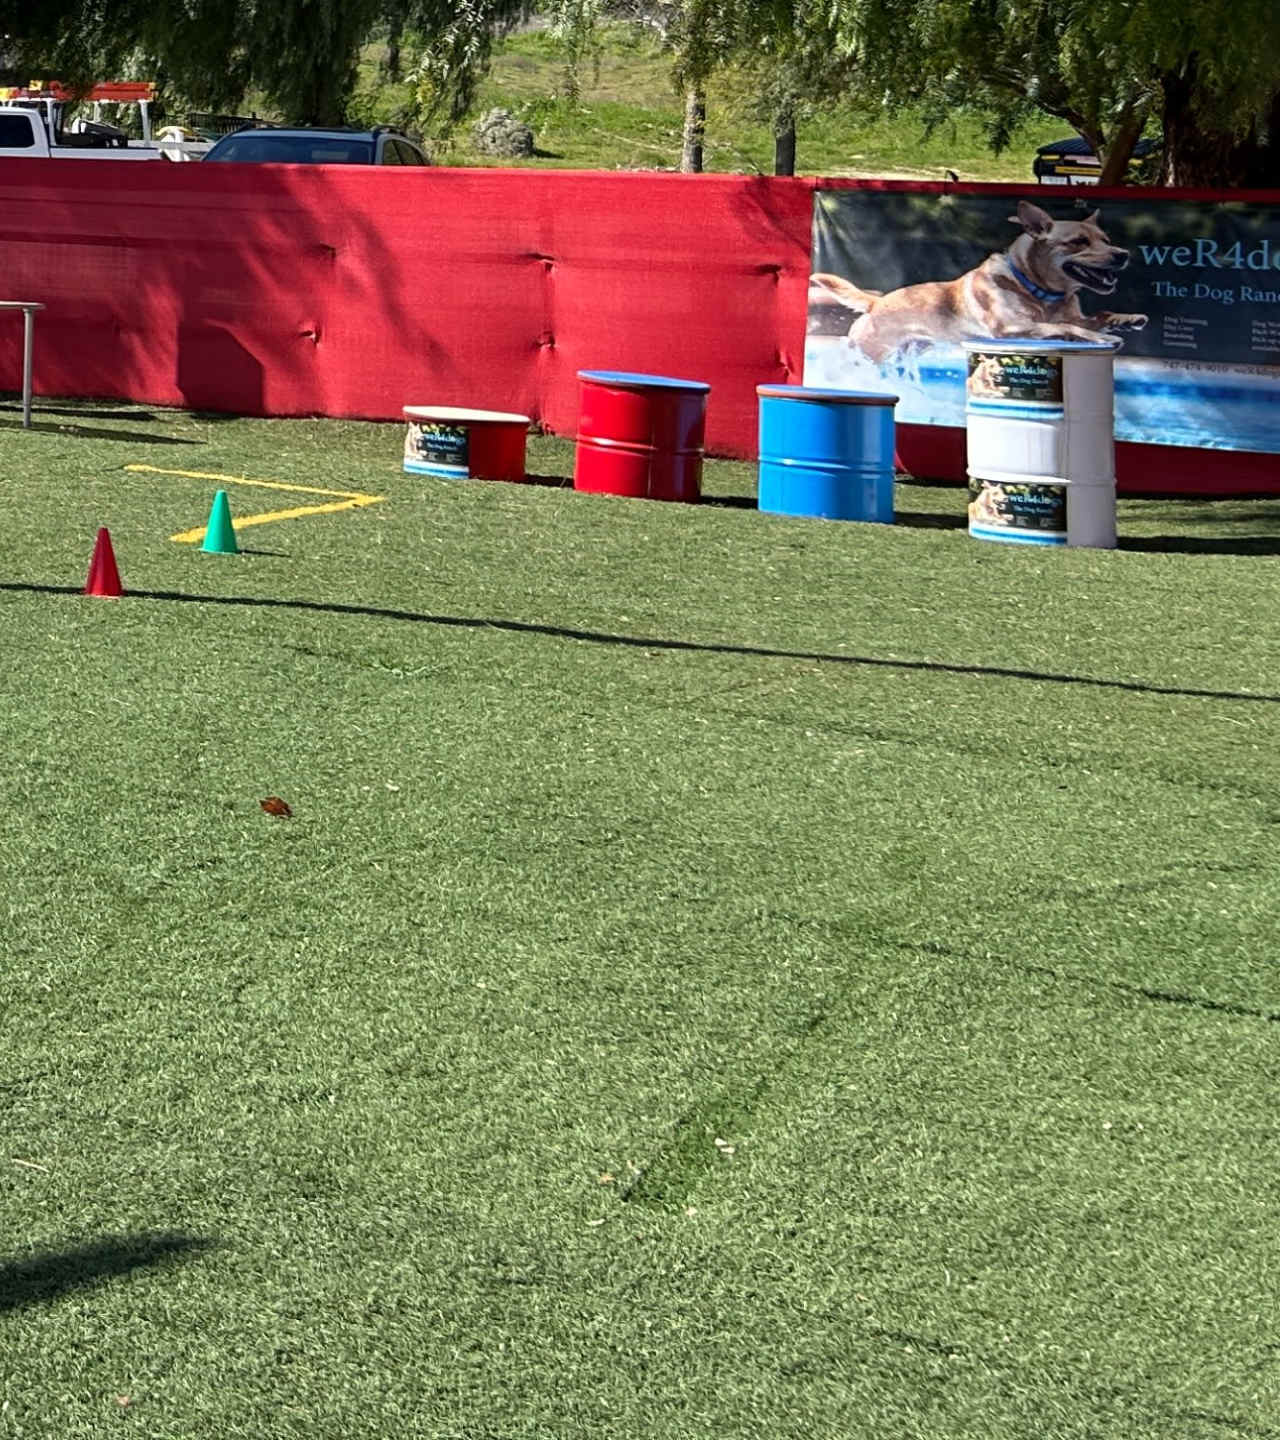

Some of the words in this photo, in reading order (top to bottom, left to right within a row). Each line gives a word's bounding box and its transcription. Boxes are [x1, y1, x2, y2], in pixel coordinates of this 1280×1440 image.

[1151, 280, 1189, 298] The
[1194, 283, 1235, 305] Dog
[1240, 285, 1280, 303] Ran
